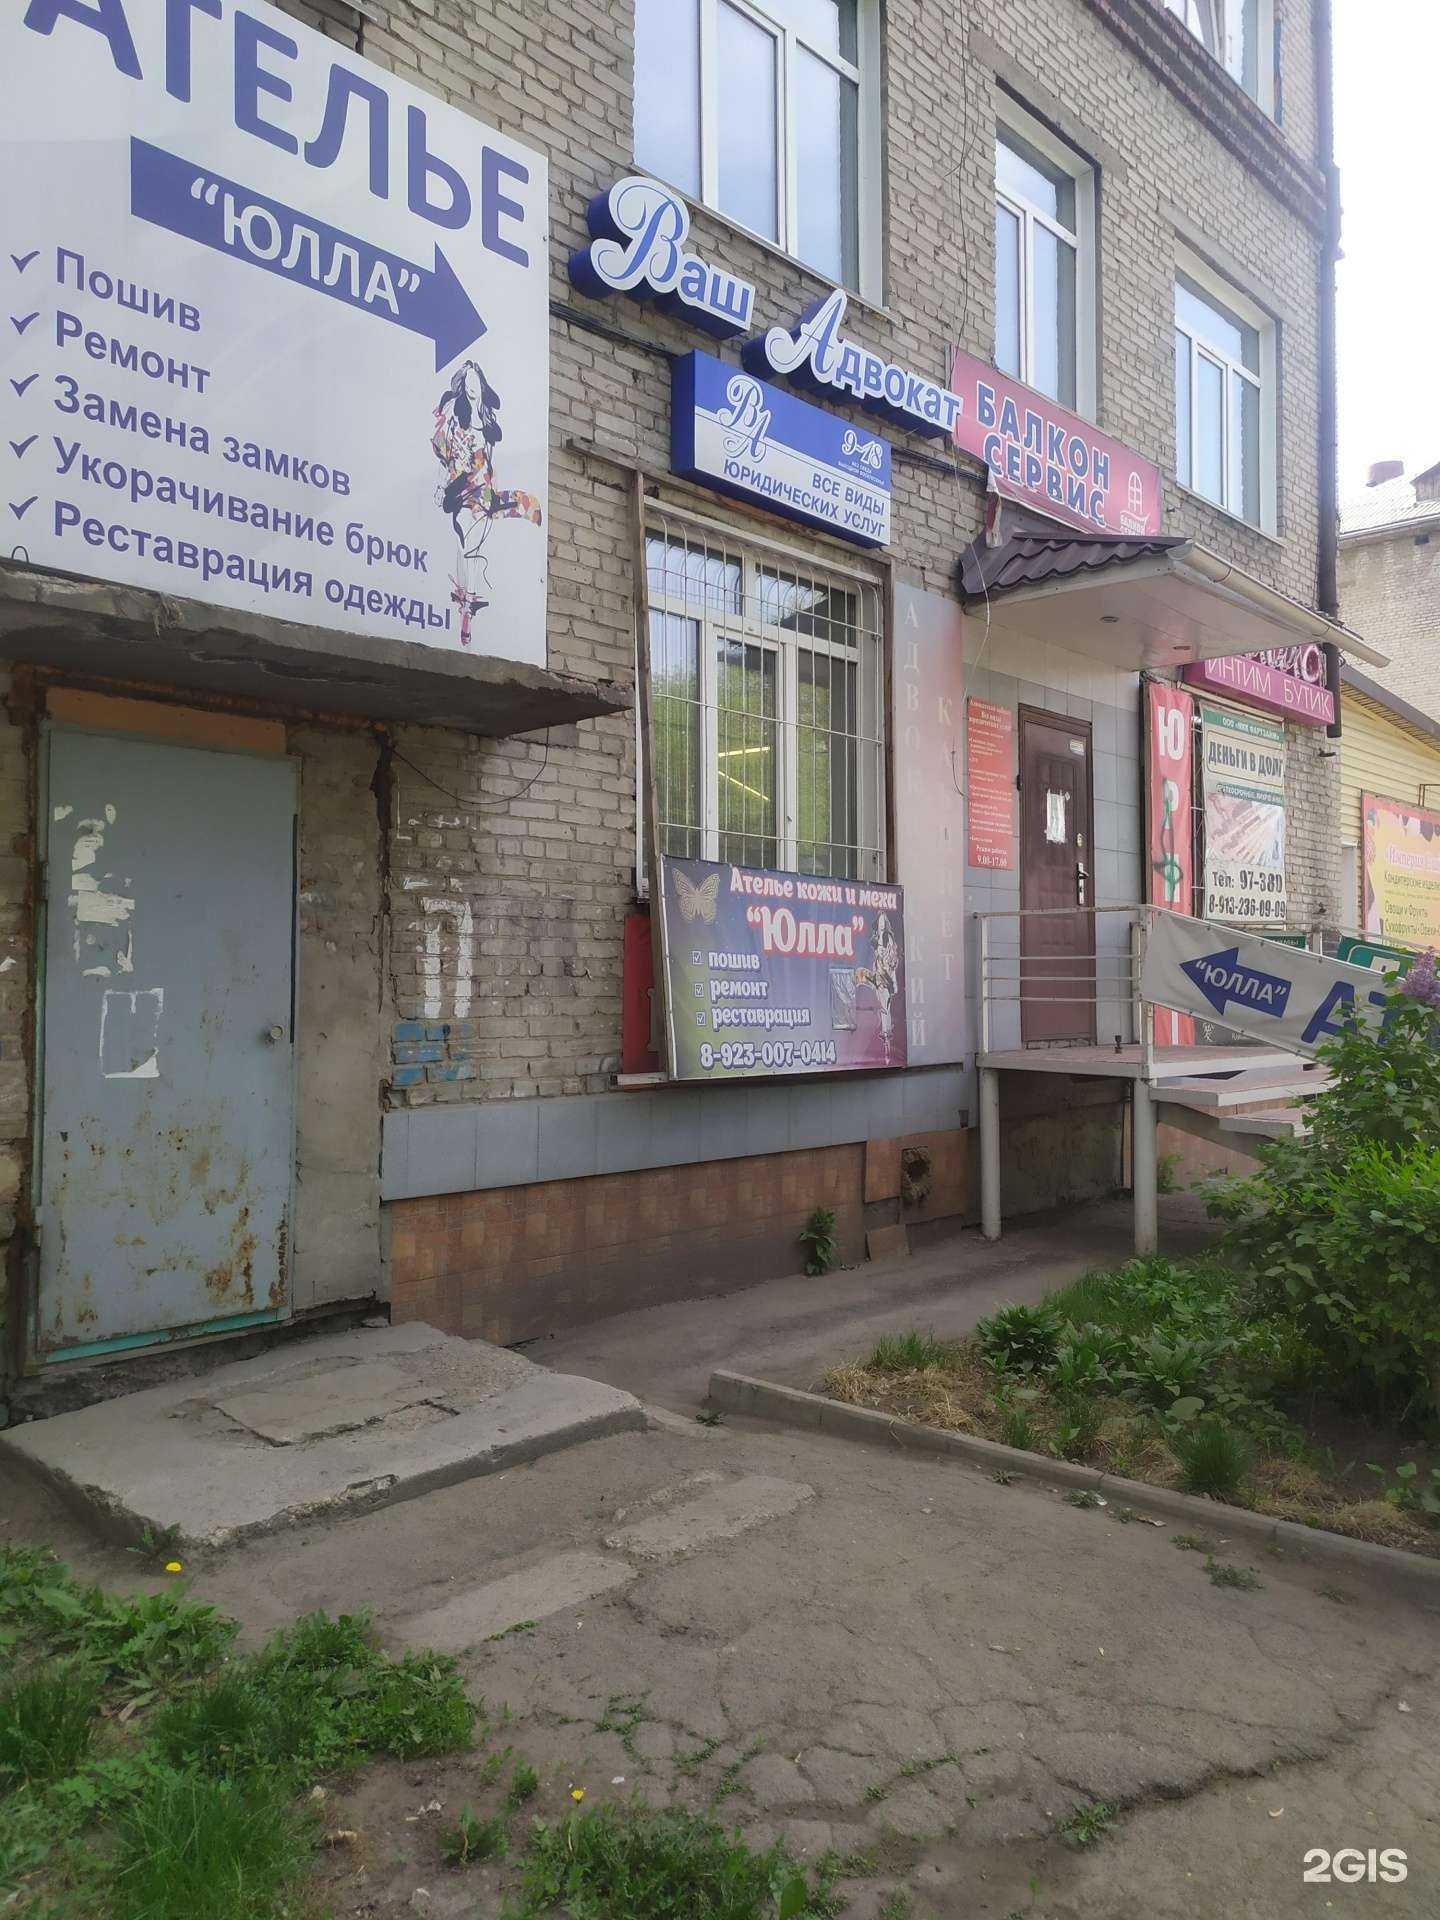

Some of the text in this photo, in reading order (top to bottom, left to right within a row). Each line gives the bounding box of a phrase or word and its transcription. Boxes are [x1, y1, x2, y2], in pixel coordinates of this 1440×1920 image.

[594, 180, 753, 327] Ваш
[56, 246, 201, 332] Пошив
[56, 312, 211, 395] Ремонт
[54, 375, 351, 496] Замена замков
[977, 380, 1110, 492] БАЛКОН
[53, 436, 428, 573] Укорачивание брюк
[724, 460, 839, 520] ЮРИДИЧЕСКИХ
[844, 511, 885, 537] УСЛУГ
[813, 473, 841, 498] ВСЕ
[845, 489, 885, 516] ВИДЫ
[984, 432, 1106, 527] СЕРВИС
[54, 500, 452, 630] Реставрация одежды
[1208, 657, 1271, 696] ИНТИМ
[1284, 679, 1331, 717] БУТИК
[1209, 741, 1248, 770] ДЕНЬГИ
[1250, 752, 1256, 772] В
[730, 866, 897, 910] Ателье кожи и меха
[1209, 894, 1286, 918] 8-913-236-09-09
[708, 952, 760, 969] пошив
[746, 906, 864, 957] “Юлла”
[710, 980, 768, 1002] ремонт
[712, 1008, 811, 1029] реставрация
[700, 1041, 836, 1068] 8-923-007-0414
